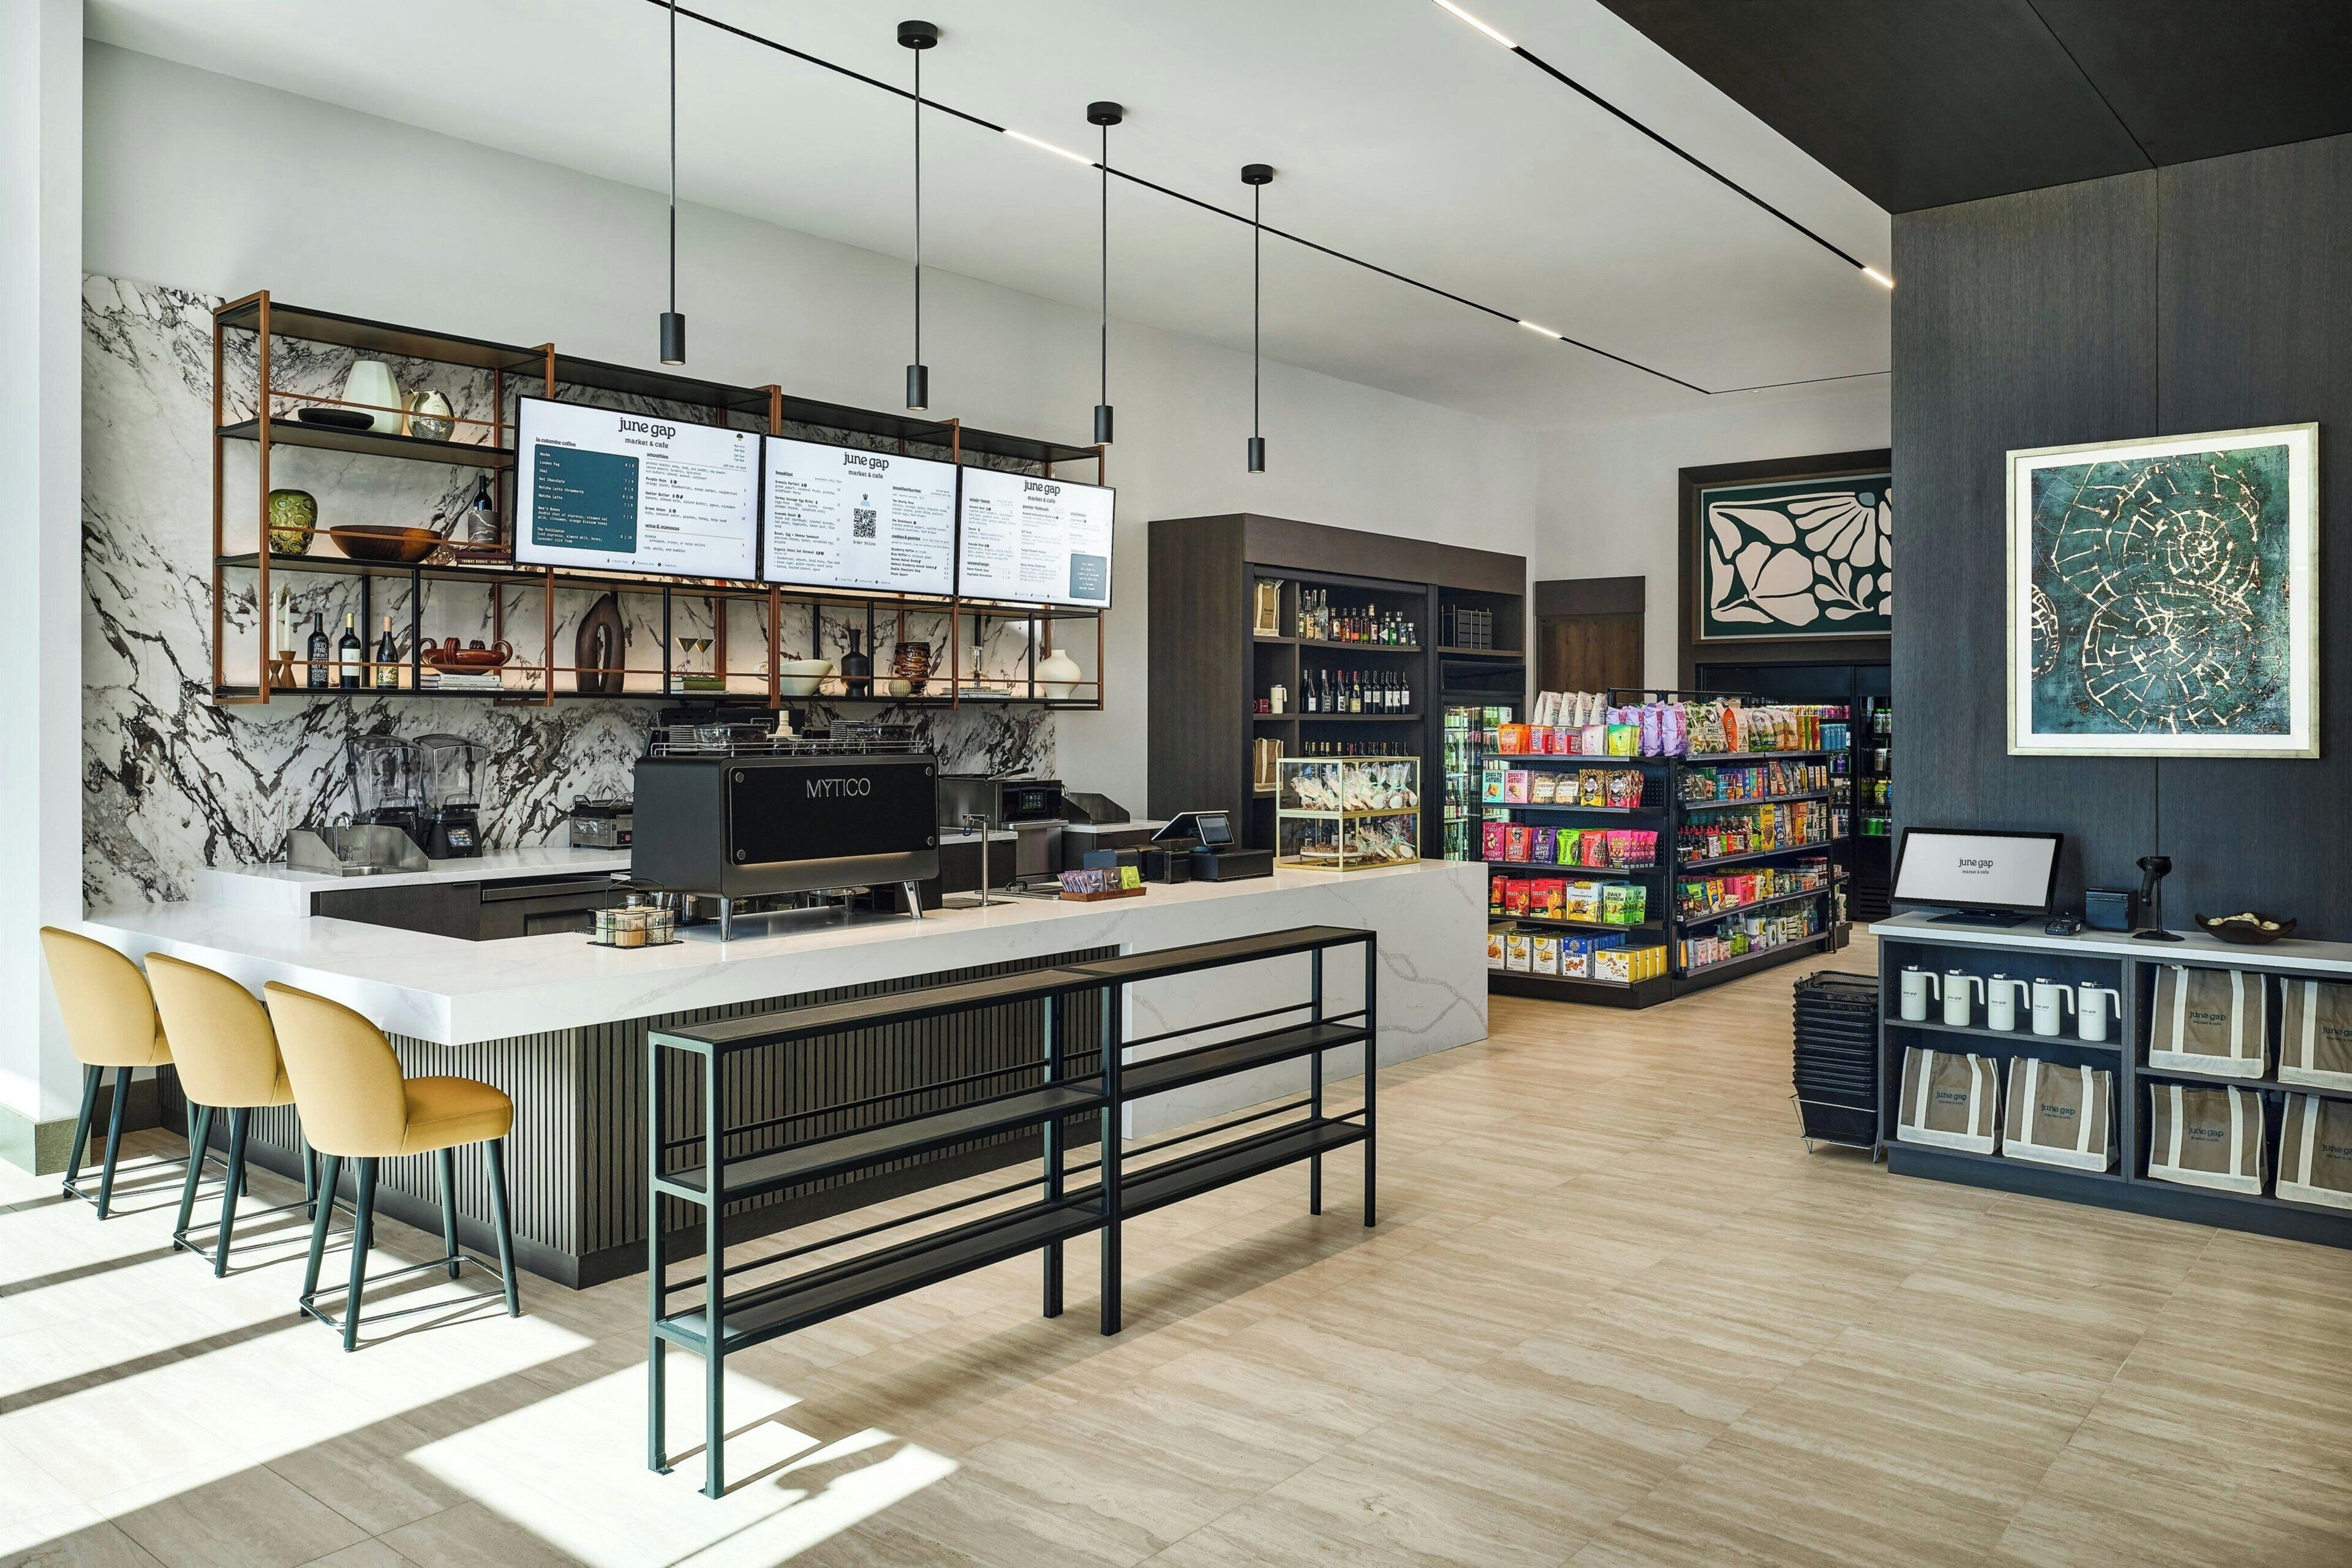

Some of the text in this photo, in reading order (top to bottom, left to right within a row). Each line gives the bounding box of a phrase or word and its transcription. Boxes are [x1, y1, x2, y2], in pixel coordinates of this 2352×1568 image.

[619, 417, 676, 440] june gap
[625, 437, 647, 446] market
[843, 452, 889, 471] june gap
[1023, 480, 1060, 497] june gap
[807, 778, 870, 797] MYTICO
[1958, 858, 1977, 867] june
[2188, 1011, 2209, 1019] june
[2323, 1026, 2342, 1035] june
[2041, 1103, 2059, 1113] june
[2321, 1144, 2342, 1153] june
